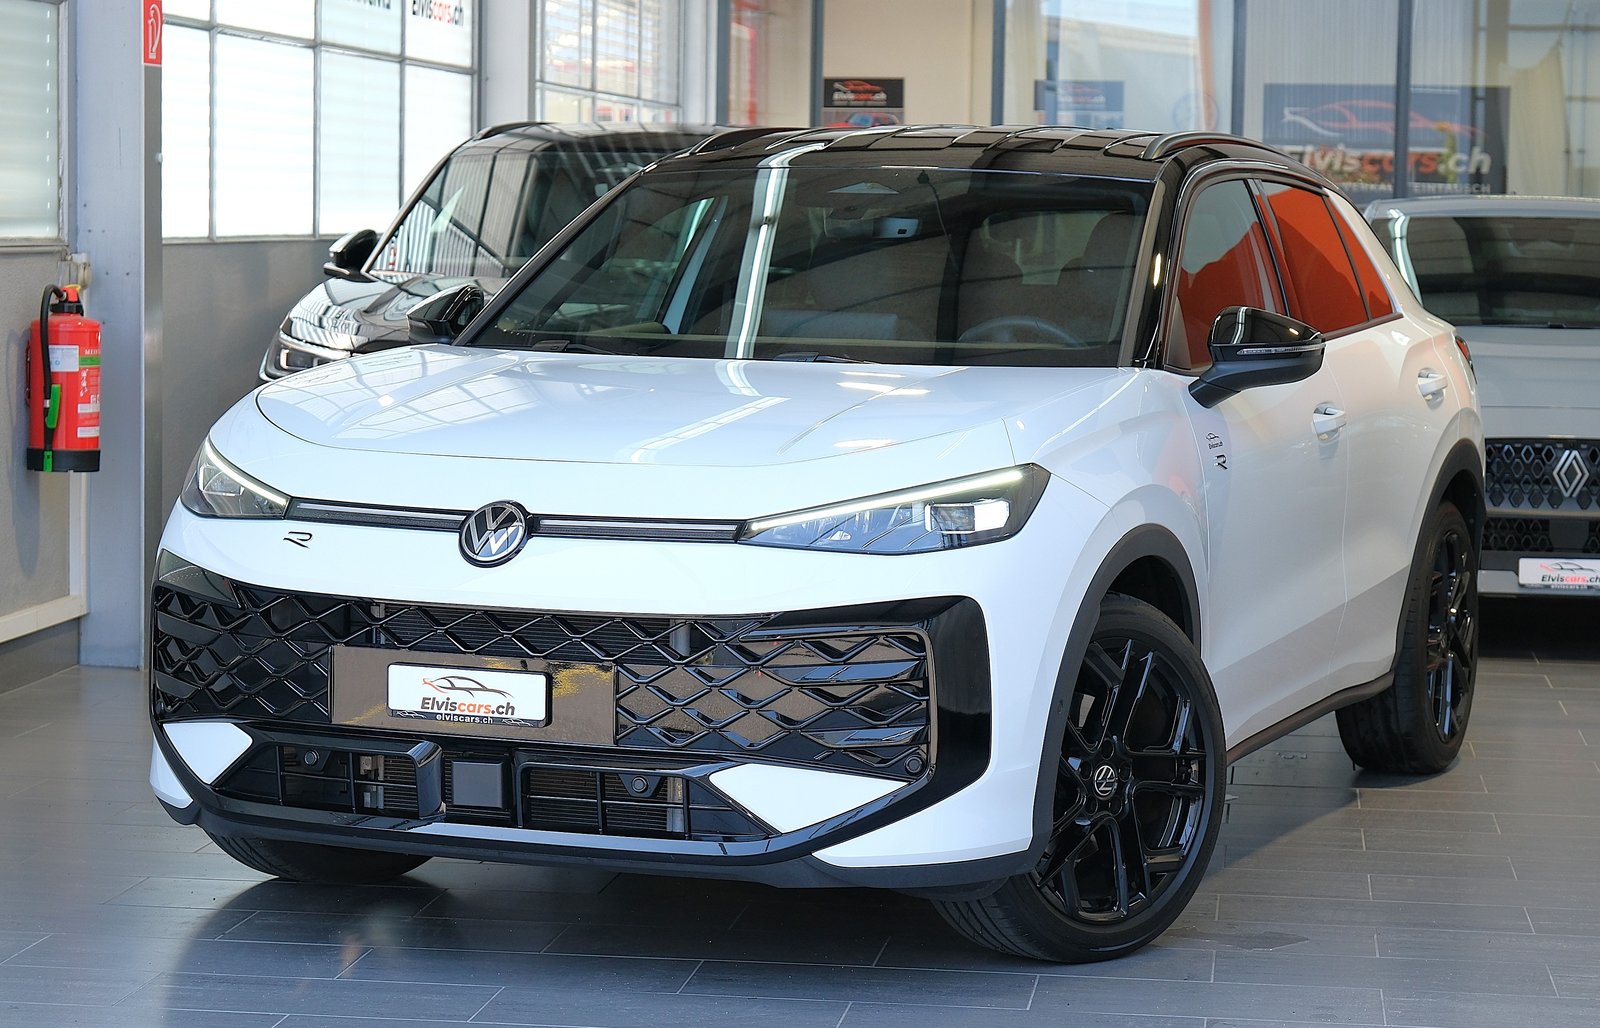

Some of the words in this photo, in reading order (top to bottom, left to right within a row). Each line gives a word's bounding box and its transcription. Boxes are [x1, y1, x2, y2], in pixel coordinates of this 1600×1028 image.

[412, 0, 464, 26] Elviscars.ch
[420, 697, 516, 716] Elviscars.ch
[436, 713, 493, 725] elviscars.ch
